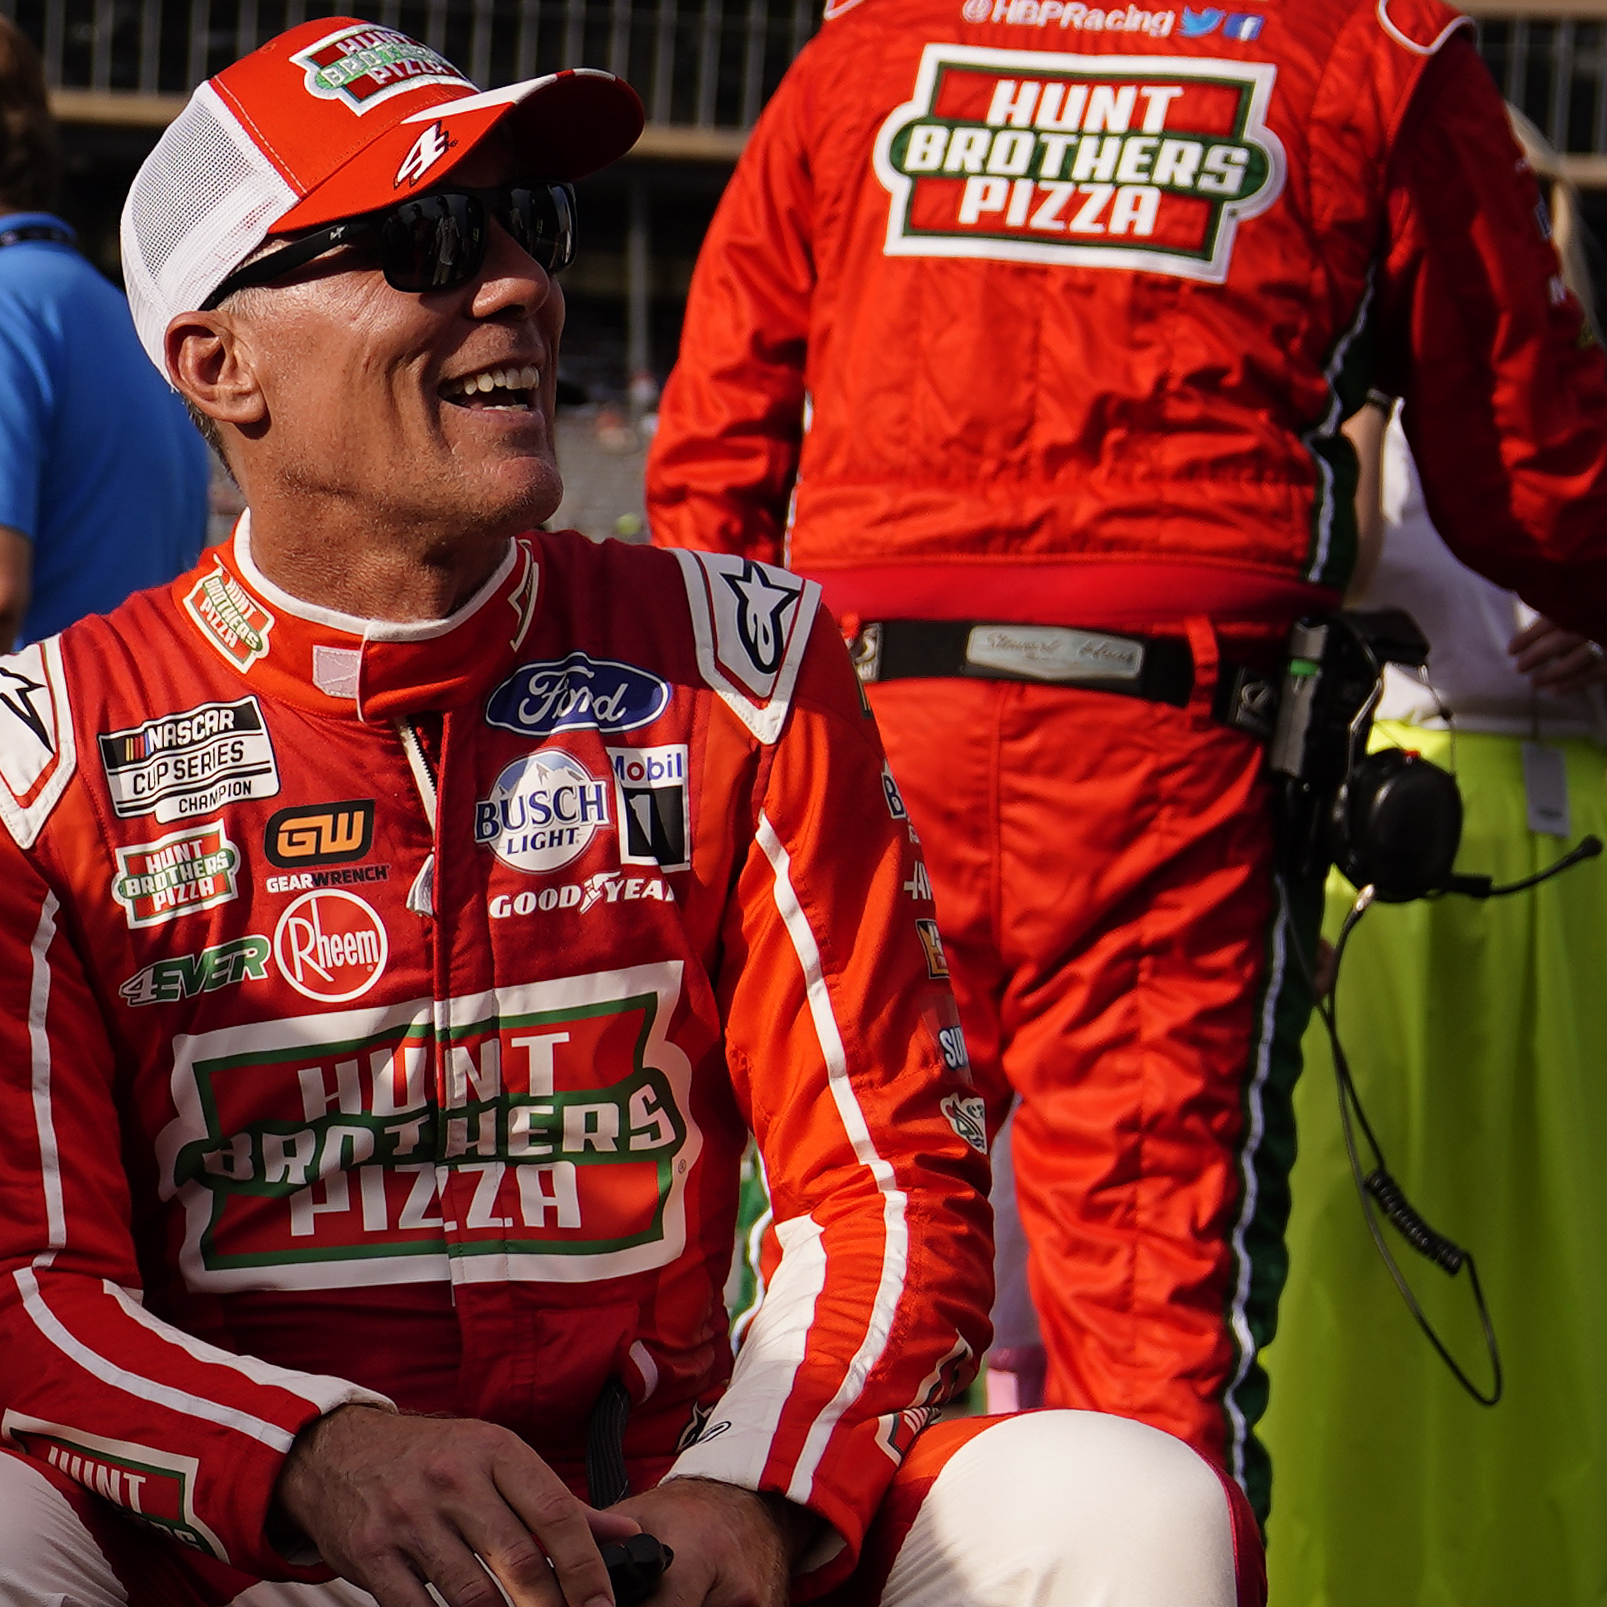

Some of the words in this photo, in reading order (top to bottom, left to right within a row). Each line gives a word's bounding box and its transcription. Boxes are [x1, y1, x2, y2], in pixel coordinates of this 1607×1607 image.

[961, 0, 1176, 38] @HBPRacing
[366, 58, 450, 86] PIZZA
[986, 79, 1184, 134] HUNT
[903, 124, 1250, 196] BROTHERS
[957, 175, 1162, 236] PIZZA
[199, 595, 239, 649] PIZZA
[205, 578, 260, 650] BROTHERS
[519, 665, 629, 725] Ford
[147, 709, 235, 753] NASCAR
[132, 761, 169, 796] CUP
[174, 740, 246, 780] SERIES
[178, 780, 252, 814] CHAMPION
[475, 784, 606, 841] BUSCH
[145, 838, 204, 874] HUNT
[277, 809, 365, 858] GW
[506, 827, 581, 855] LIGHT
[124, 852, 230, 898] BROTHERS
[152, 876, 215, 912] PIZZA
[265, 866, 388, 893] GEARWRENCH
[287, 898, 379, 982] Rheem
[119, 934, 271, 1006] 4EVER
[297, 1032, 570, 1123] HUNT
[202, 1083, 677, 1185] BROTHERS
[289, 1160, 582, 1237] PIZZA
